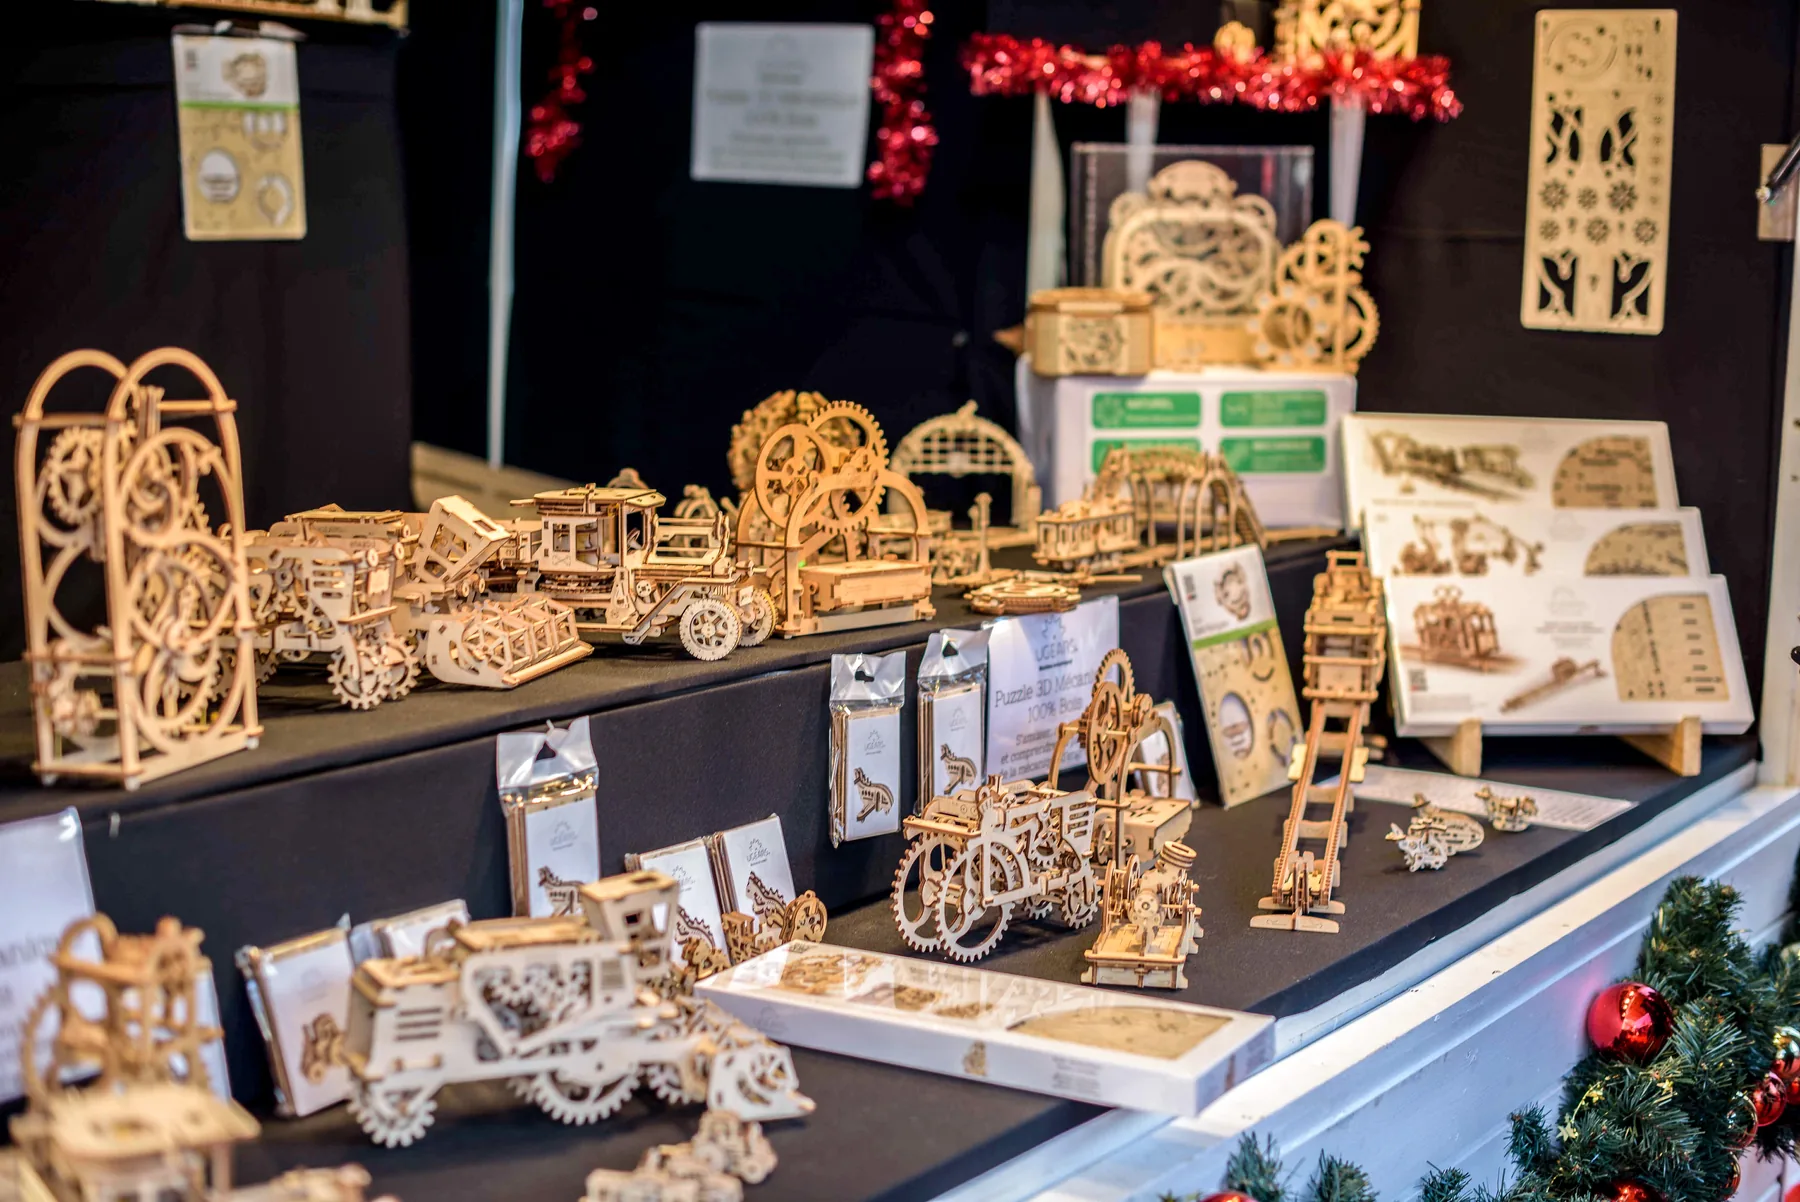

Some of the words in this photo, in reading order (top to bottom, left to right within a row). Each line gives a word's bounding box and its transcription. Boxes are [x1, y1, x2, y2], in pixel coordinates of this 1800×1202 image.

[995, 684, 1034, 708] Puzzle
[1036, 679, 1053, 697] 3D
[1027, 701, 1056, 723] 100%
[1059, 697, 1083, 714] Bois
[1000, 753, 1009, 765] et
